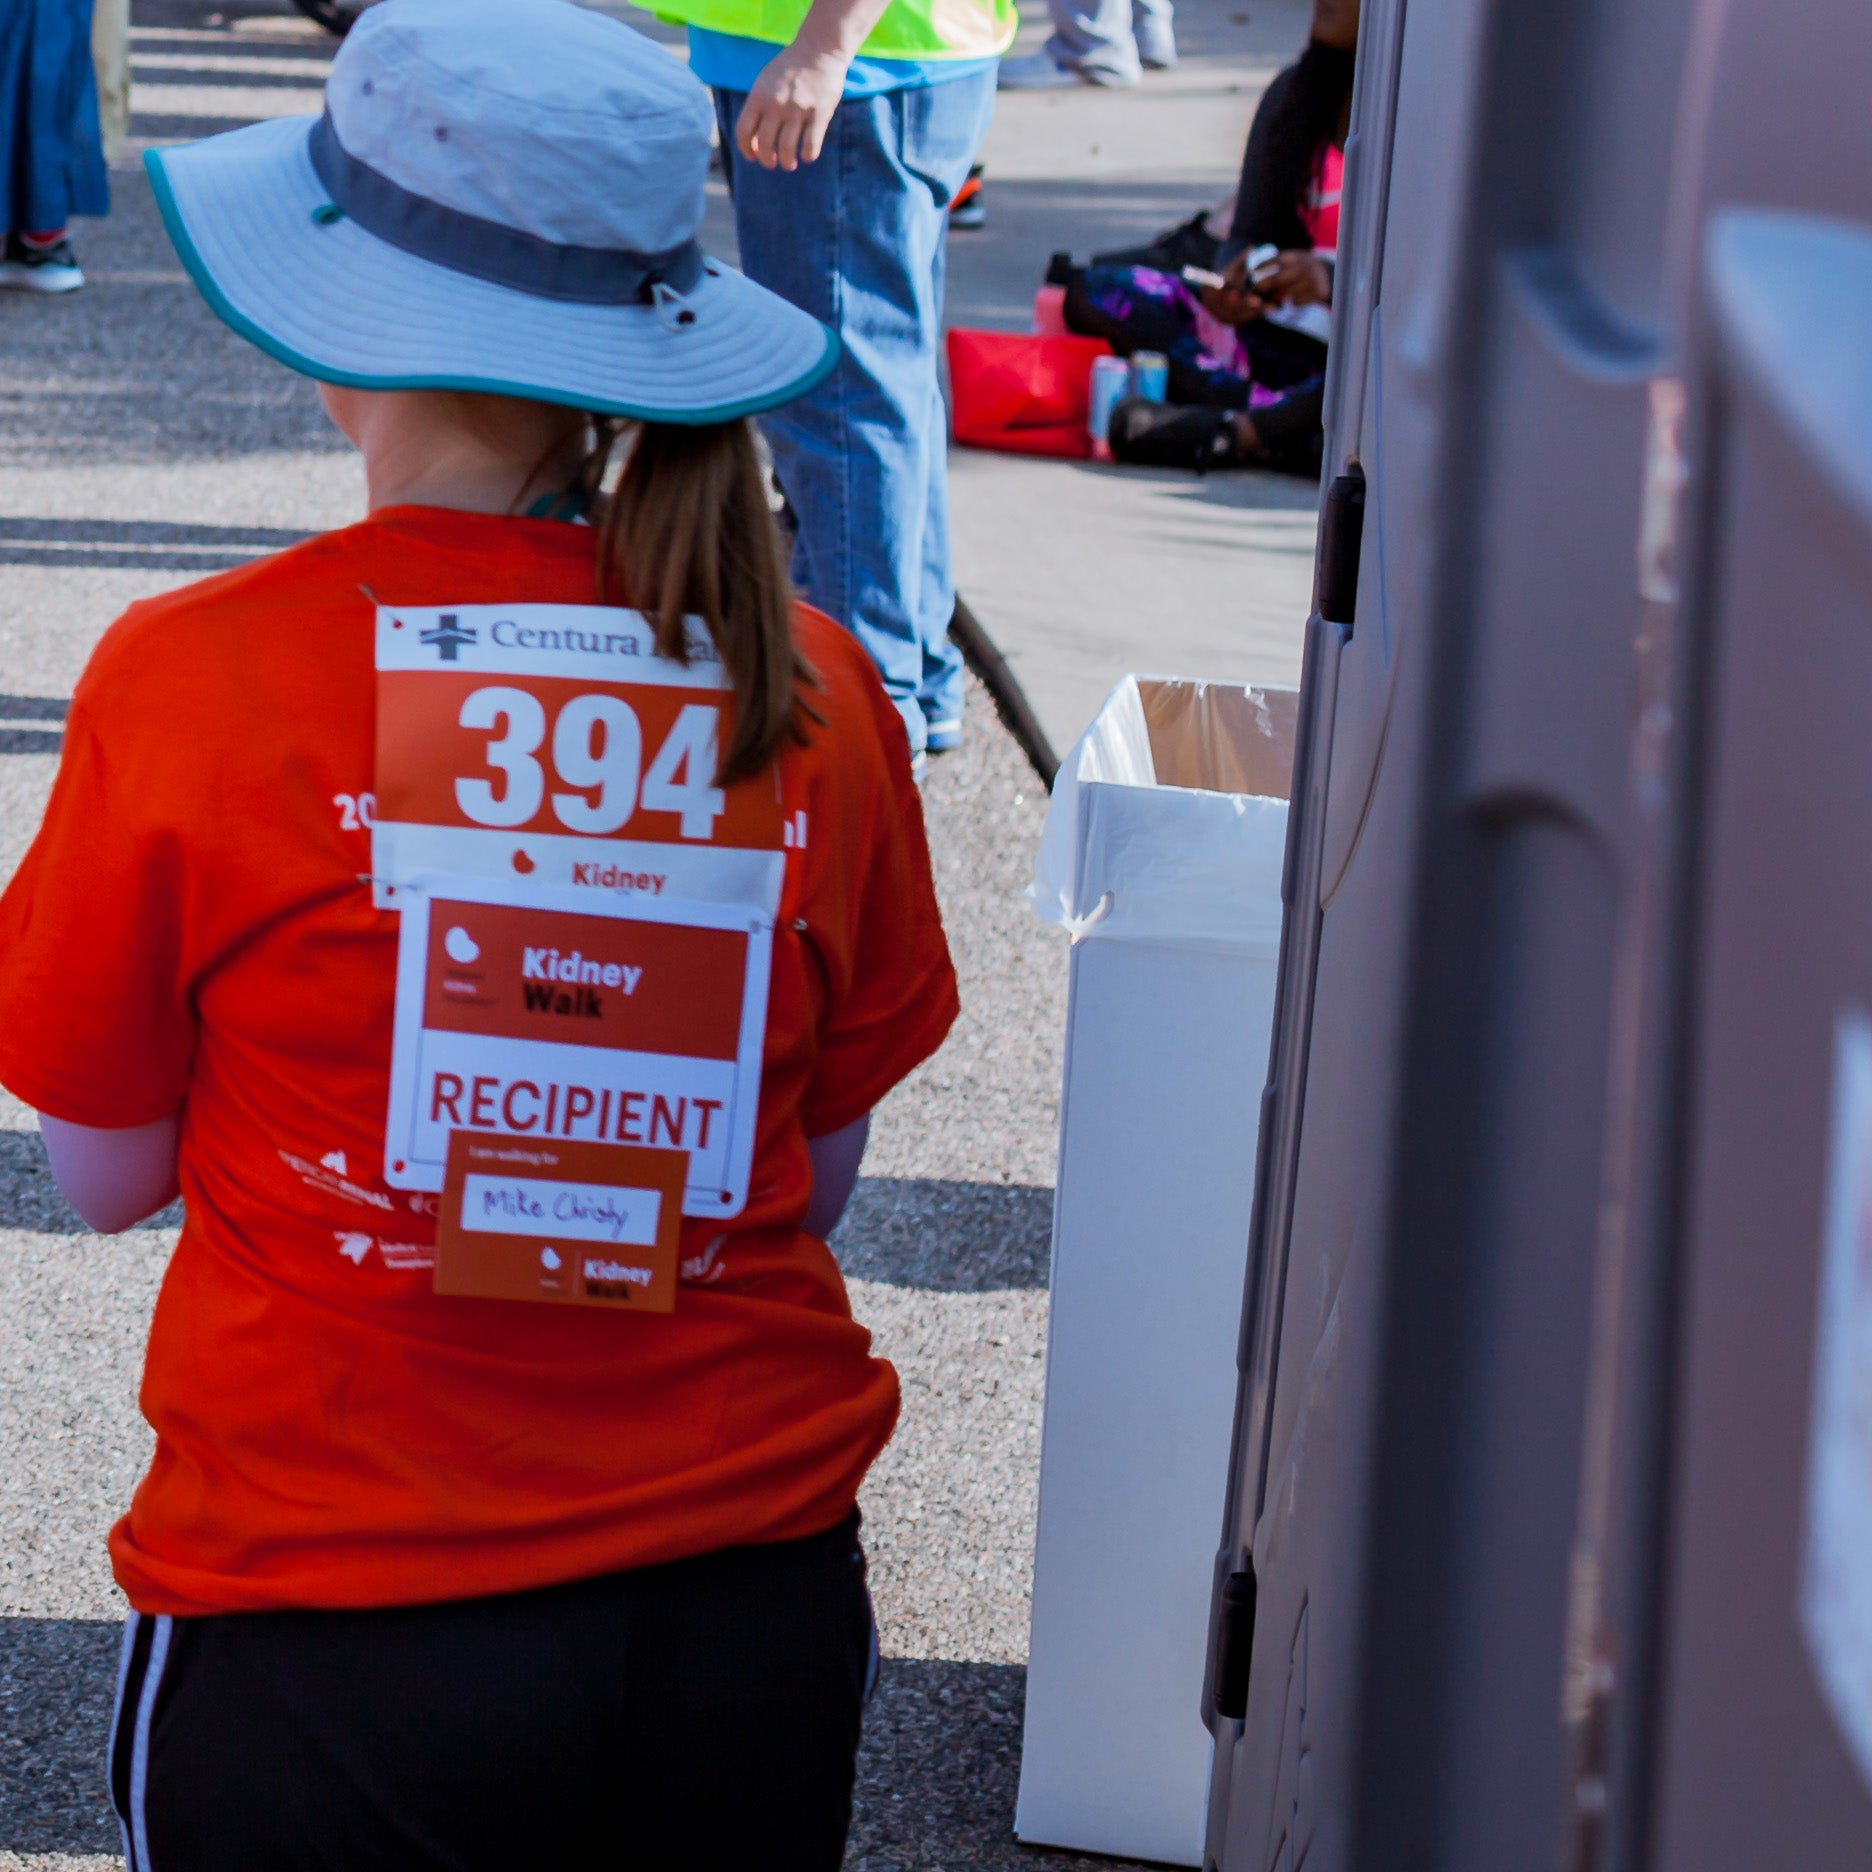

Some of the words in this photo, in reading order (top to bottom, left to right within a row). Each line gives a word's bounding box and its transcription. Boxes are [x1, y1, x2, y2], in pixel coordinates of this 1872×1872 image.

[491, 620, 640, 658] Centura
[455, 685, 725, 840] 394
[573, 862, 667, 896] Kidney
[522, 946, 644, 996] Kidney
[522, 983, 603, 1019] Walk
[430, 1071, 723, 1150] RECIPIENT
[483, 1188, 542, 1219] Mike
[584, 1260, 653, 1287] Kidney
[585, 1282, 631, 1301] Walk
